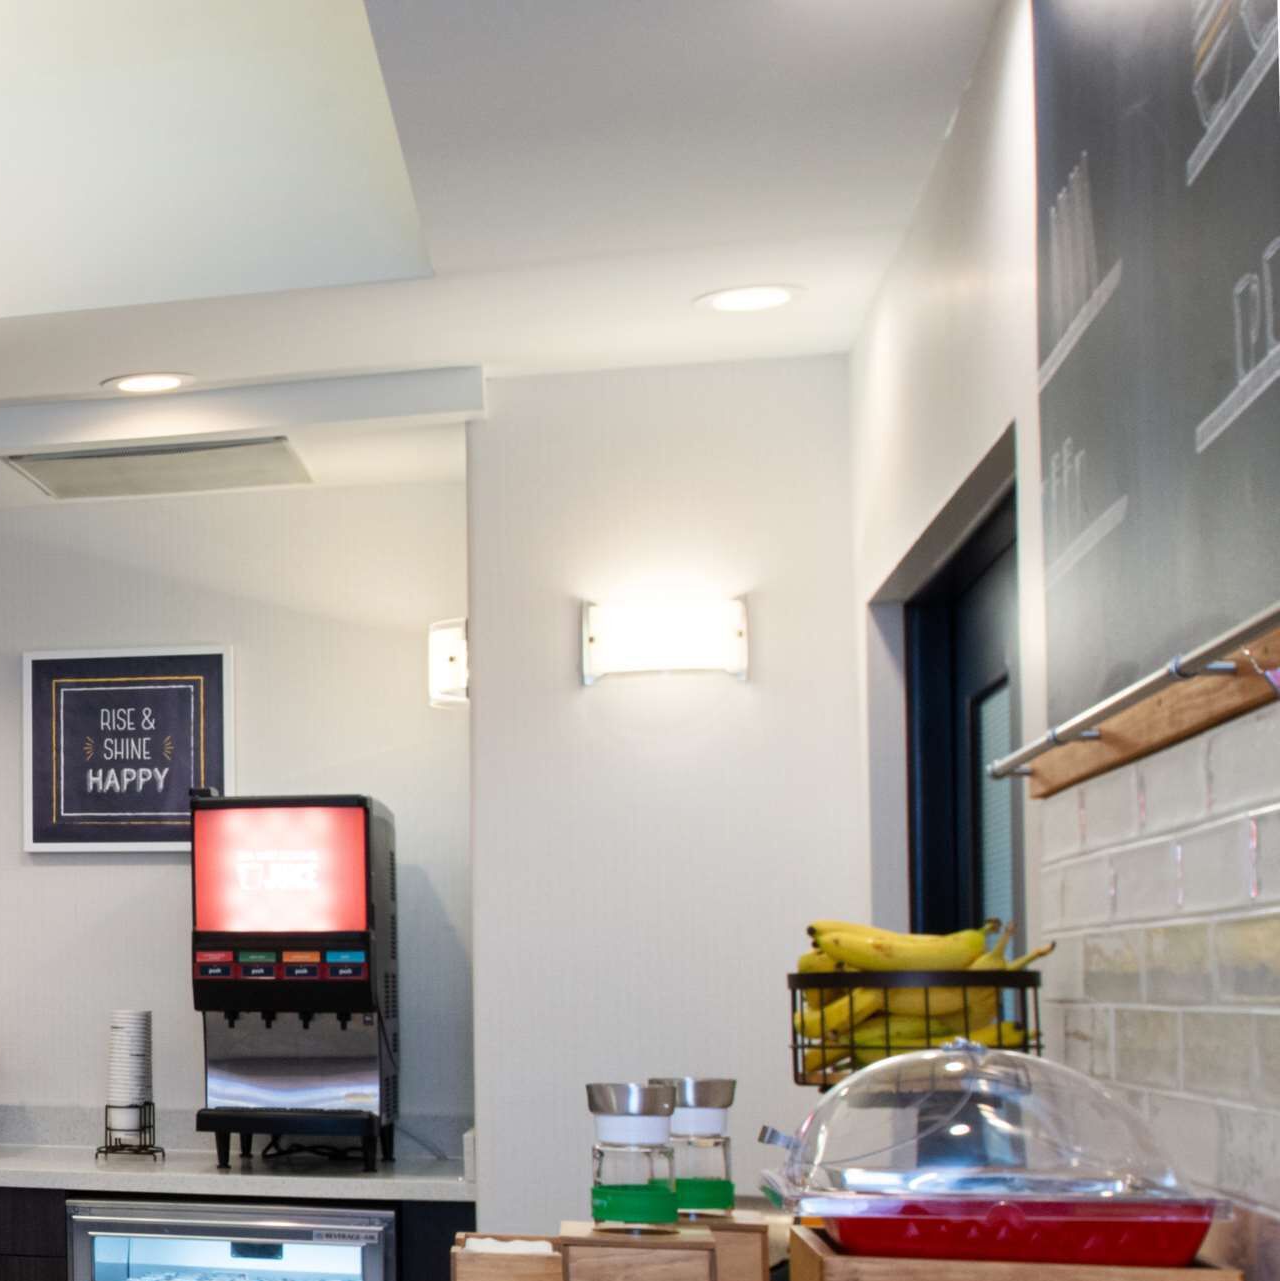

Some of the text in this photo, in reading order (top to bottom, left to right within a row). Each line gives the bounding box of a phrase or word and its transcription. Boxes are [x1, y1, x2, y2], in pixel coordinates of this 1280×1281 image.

[100, 706, 156, 731] RISE &
[103, 737, 152, 760] SHINE
[86, 767, 169, 793] HAPPY
